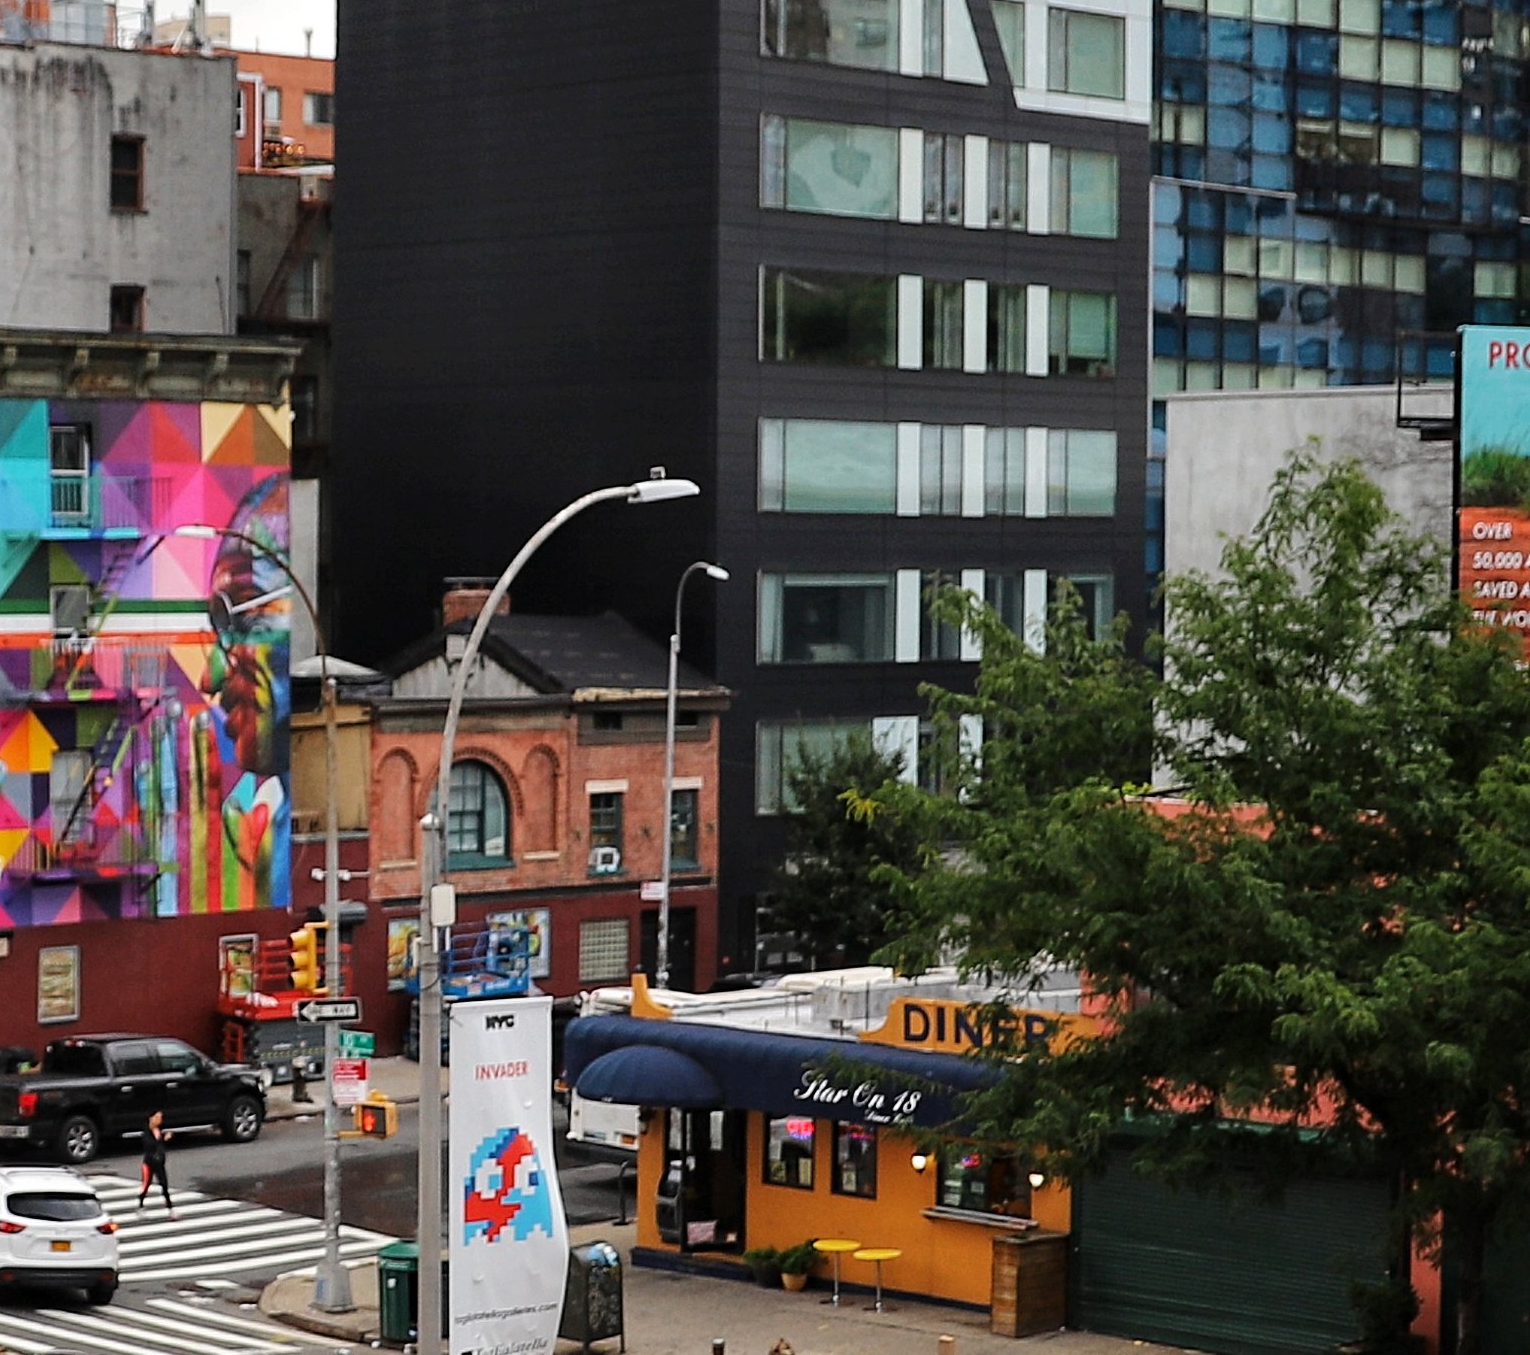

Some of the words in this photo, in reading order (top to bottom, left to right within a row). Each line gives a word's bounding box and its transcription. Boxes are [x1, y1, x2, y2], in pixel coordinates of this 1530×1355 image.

[1472, 521, 1513, 541] OVER
[1472, 551, 1522, 571] 50,000
[1473, 581, 1519, 599] SAVED
[486, 1015, 515, 1030] NYC
[904, 1003, 1054, 1049] DINER
[475, 1061, 530, 1080] INVADER
[794, 1070, 849, 1104] Star
[852, 1079, 886, 1109] On
[892, 1090, 922, 1114] 18
